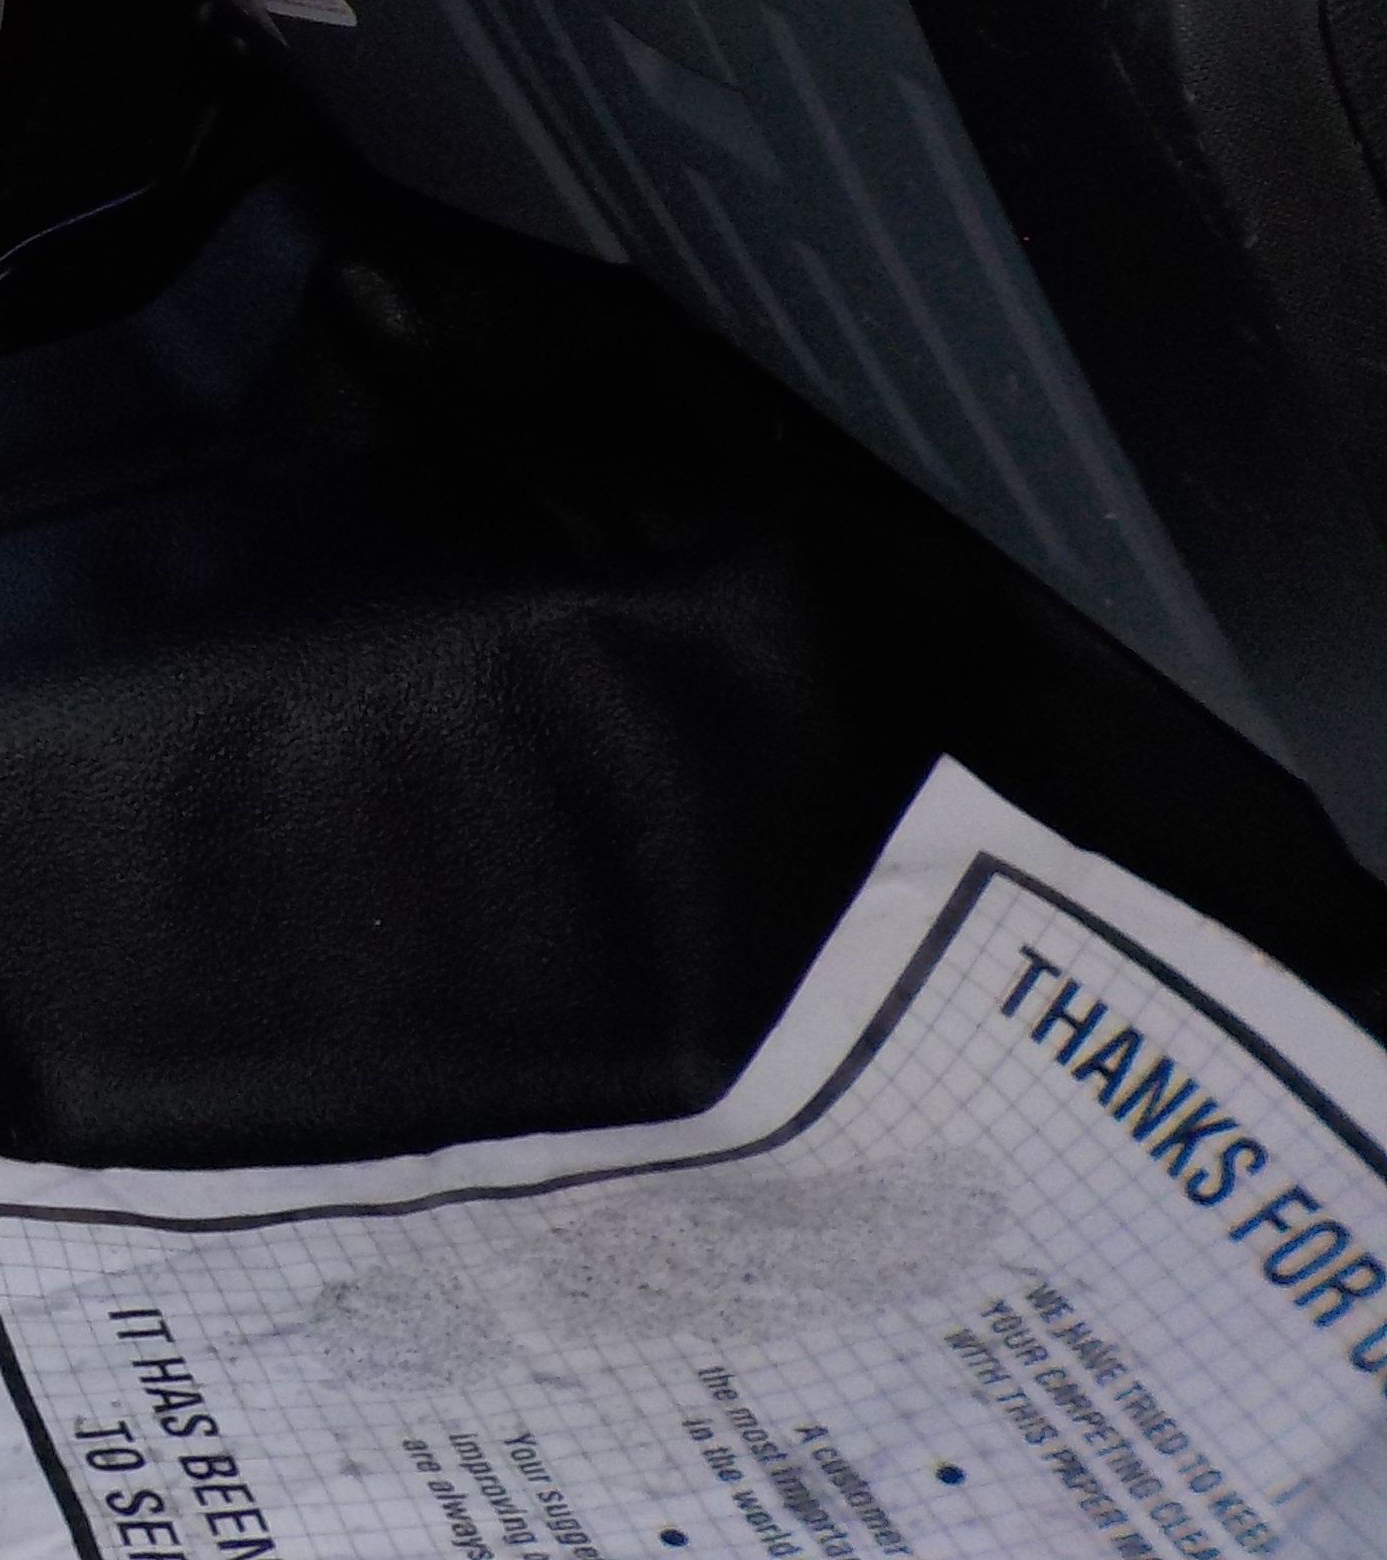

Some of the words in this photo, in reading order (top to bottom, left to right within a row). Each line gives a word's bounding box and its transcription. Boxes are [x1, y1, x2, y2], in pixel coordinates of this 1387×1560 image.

[999, 944, 1269, 1208] THANKS
[1229, 1184, 1387, 1329] FOR
[107, 1308, 176, 1343] IT
[74, 1420, 146, 1472] TO
[131, 1356, 219, 1438] HAS
[793, 1424, 829, 1443] A
[945, 1328, 1011, 1385] WITH
[996, 1386, 1060, 1446] THIS
[1042, 1447, 1129, 1530] PAPER
[982, 1299, 1049, 1367] YOUR
[1034, 1367, 1164, 1501] CARPETING
[1027, 1281, 1075, 1324] WE
[1053, 1320, 1127, 1386] HAVE
[1115, 1380, 1191, 1456] TRIED
[1177, 1452, 1223, 1494] TO
[178, 1454, 283, 1560] BEEN
[402, 1438, 442, 1473] are
[428, 1479, 495, 1560] always
[449, 1432, 538, 1545] improving
[503, 1432, 552, 1483] Your
[536, 1489, 607, 1560] sugge
[681, 1416, 715, 1441] in
[701, 1445, 744, 1482] the
[731, 1489, 804, 1558] world
[697, 1365, 738, 1402] the
[727, 1406, 788, 1464] most
[770, 1465, 863, 1560] importa
[810, 1446, 914, 1555] customer
